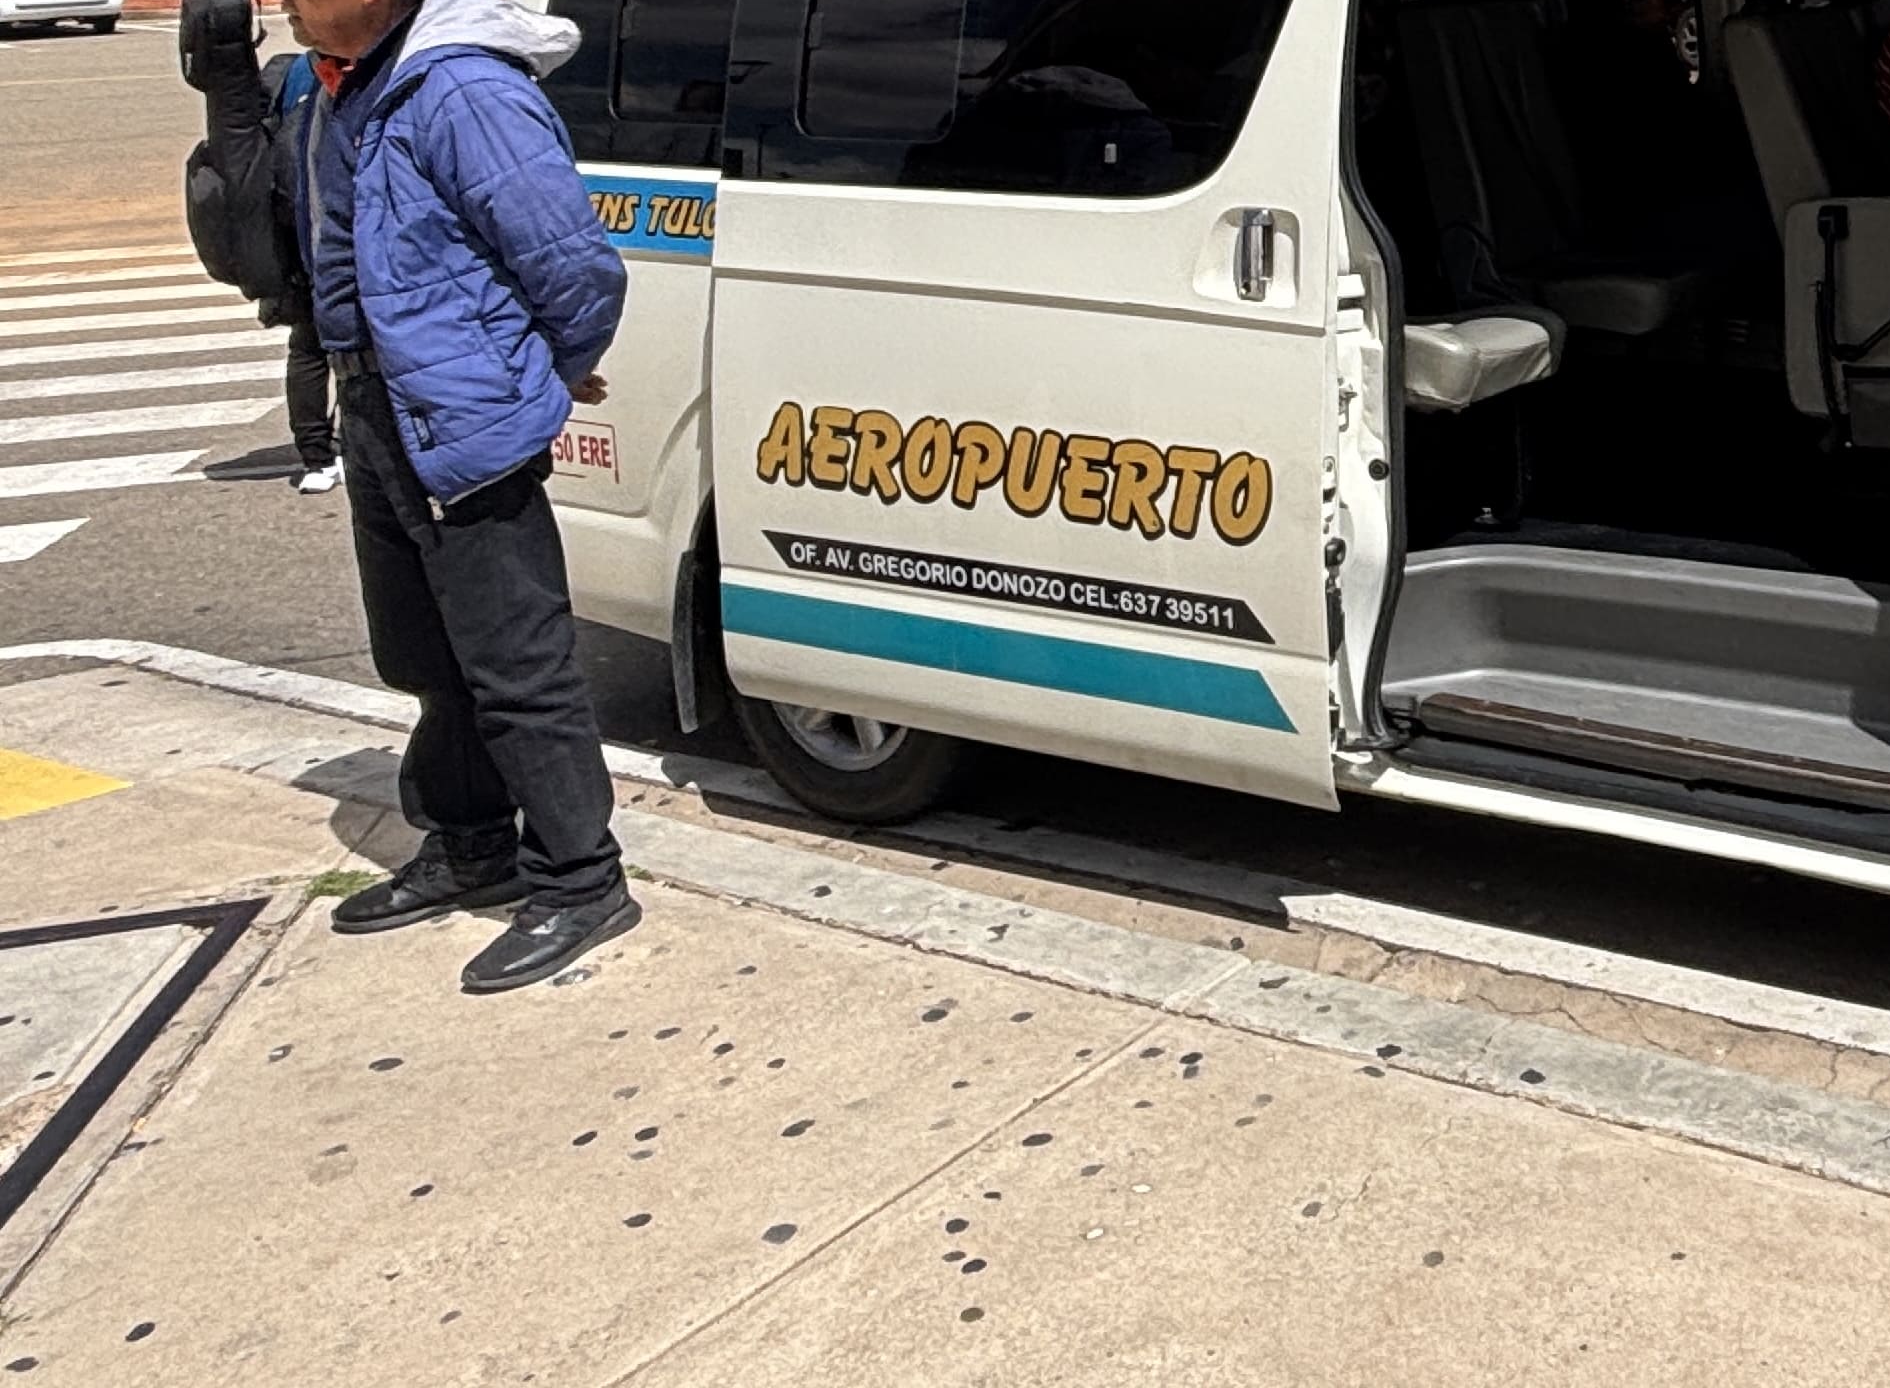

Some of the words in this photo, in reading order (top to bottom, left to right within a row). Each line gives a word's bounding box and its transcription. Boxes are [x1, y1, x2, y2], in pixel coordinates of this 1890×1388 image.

[578, 435, 612, 469] ERE
[757, 401, 1274, 546] AEROPUERTO
[790, 541, 820, 565] OF.
[825, 547, 854, 571] AV.
[859, 552, 968, 588] GREGORIO
[972, 568, 1066, 601] DONOZO
[1165, 598, 1235, 630] 39511
